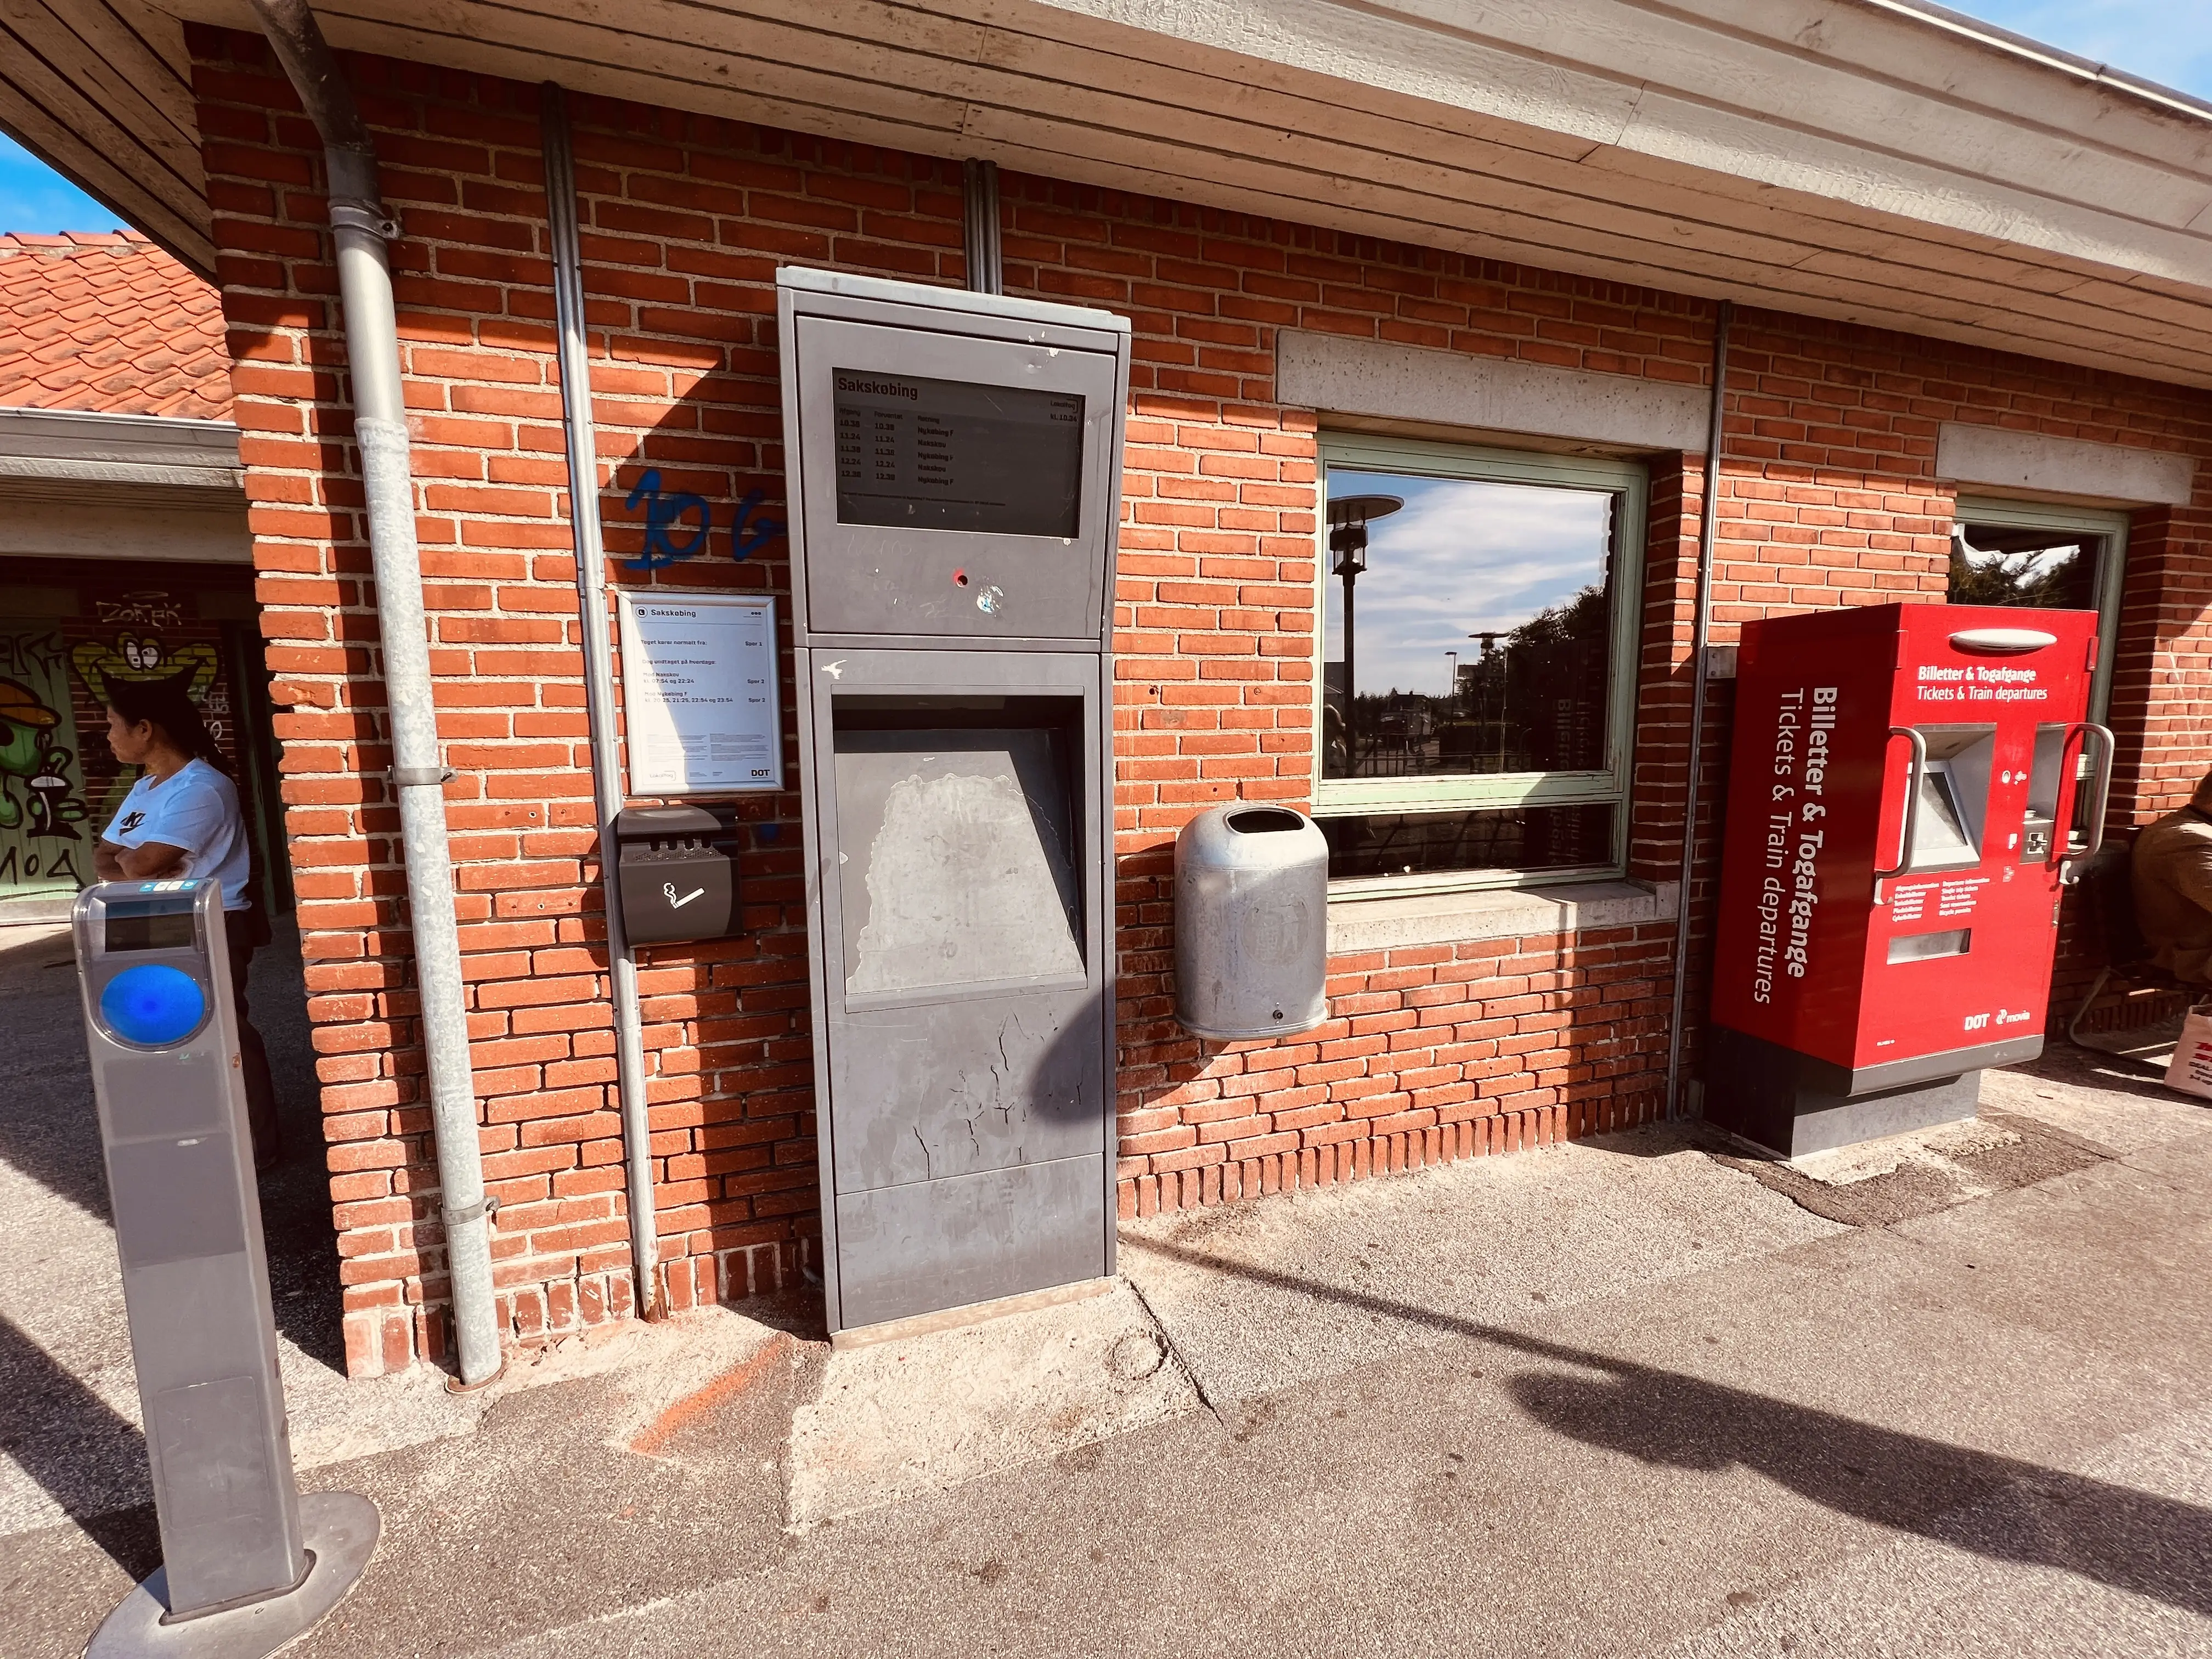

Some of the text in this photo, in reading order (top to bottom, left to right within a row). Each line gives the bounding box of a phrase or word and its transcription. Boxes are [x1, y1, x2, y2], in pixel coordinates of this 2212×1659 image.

[838, 377, 918, 400] Sakskøbing
[651, 610, 696, 618] Sakskøbing
[1918, 665, 2036, 684] Billetter & Togafgange
[1917, 685, 2048, 703] Tickets & Train departures
[1784, 687, 1837, 978] Billetter & Togafgange
[1754, 687, 1803, 1004] Tickets & Train departures
[1964, 1013, 1990, 1031] DOT
